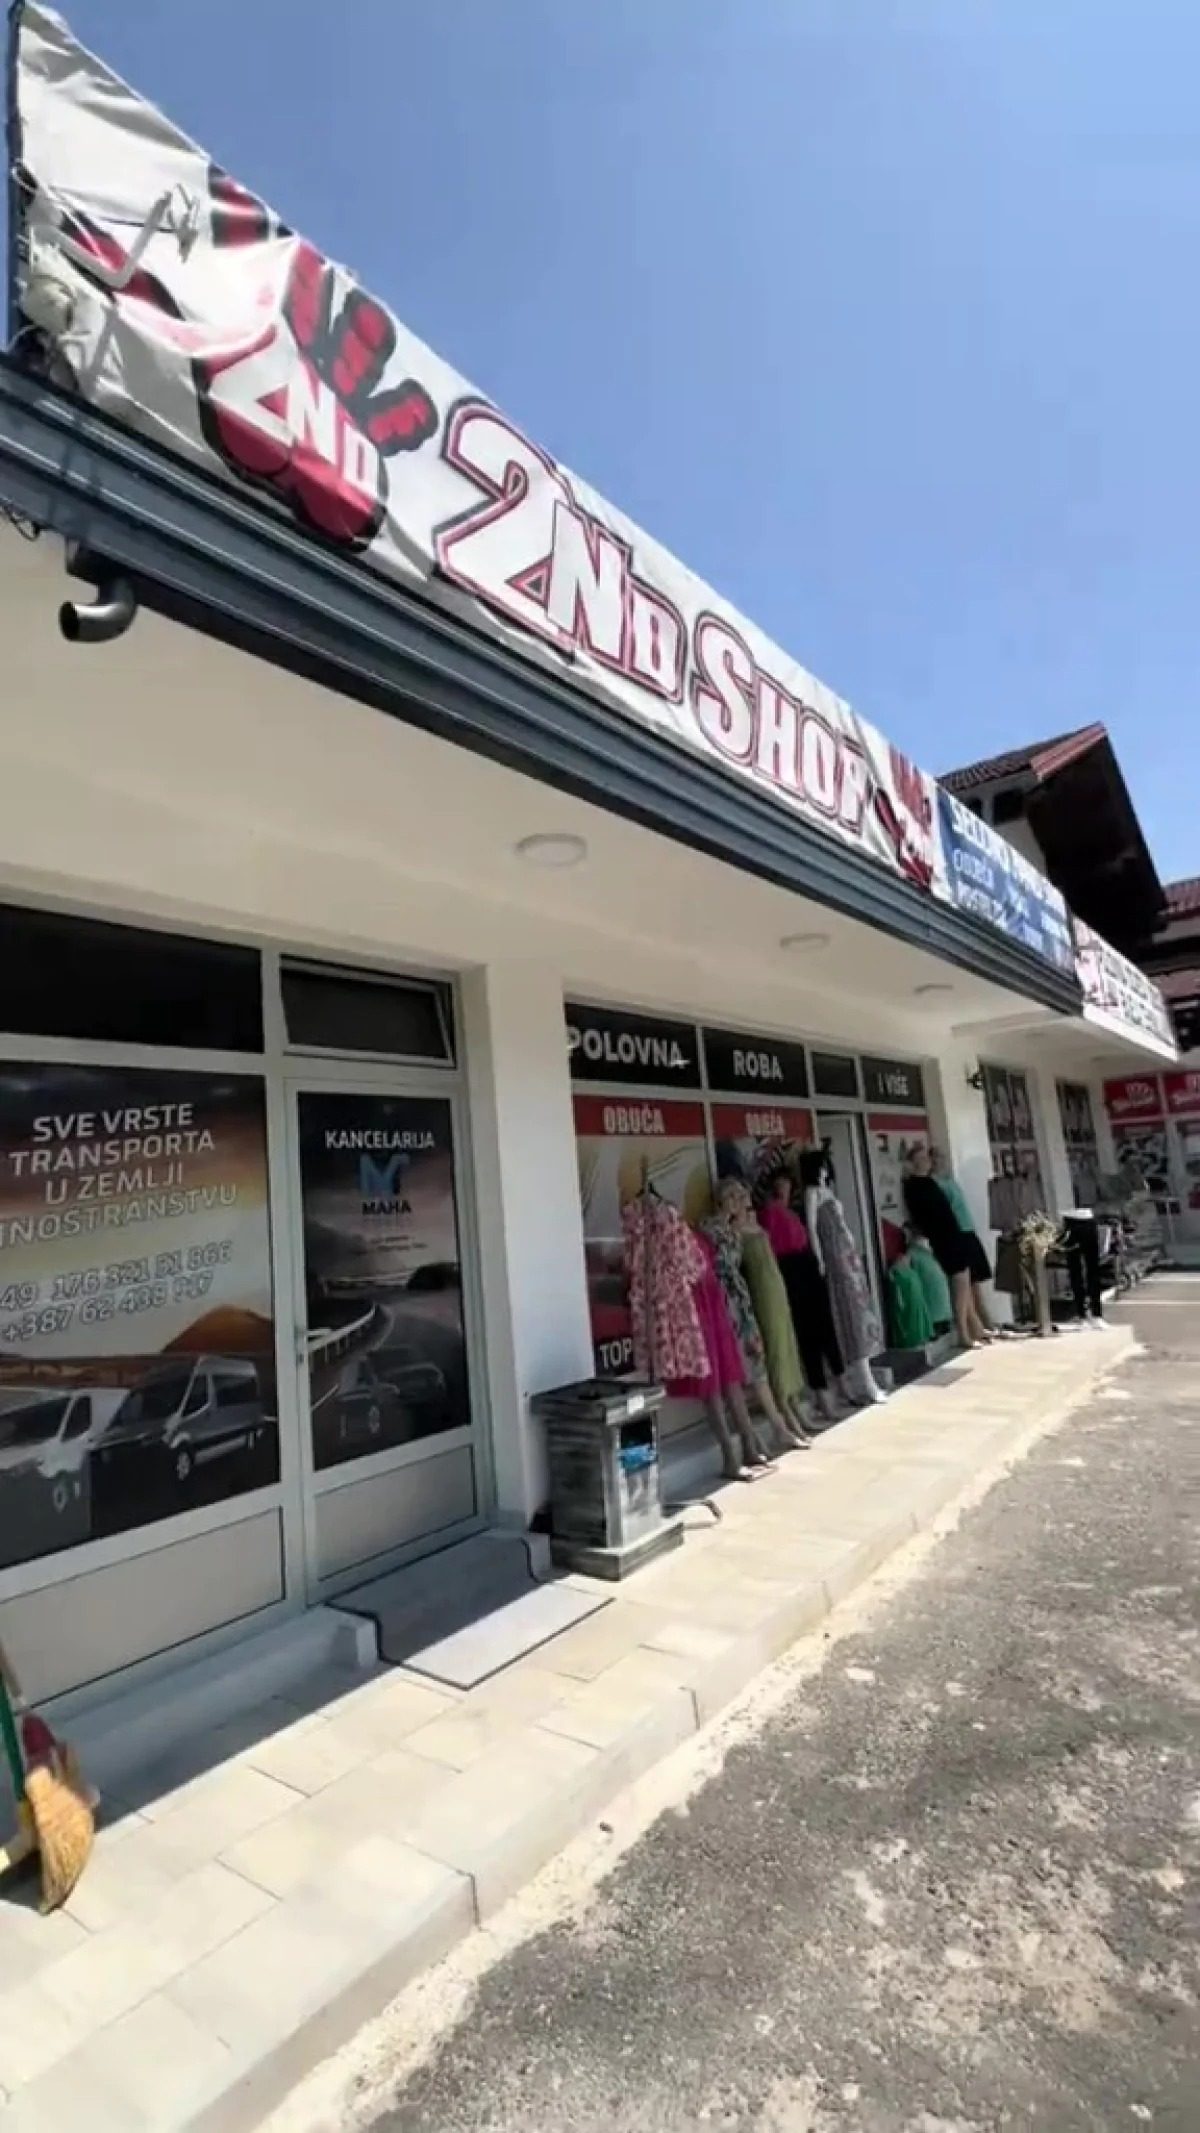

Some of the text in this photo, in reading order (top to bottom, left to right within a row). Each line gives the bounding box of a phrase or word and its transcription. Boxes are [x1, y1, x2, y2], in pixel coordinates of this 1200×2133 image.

[433, 396, 687, 703] 2ND
[566, 1026, 689, 1067] POLOVNA
[733, 1050, 784, 1081] ROBA
[33, 1103, 194, 1143] SVE VRSTE
[324, 1129, 436, 1149] KANCELARIJA
[9, 1129, 215, 1177] TRANSPORTA
[45, 1161, 183, 1205] U ZEMLJI
[362, 1200, 412, 1216] MAHA
[3, 1301, 76, 1342] +387
[598, 1337, 633, 1370] TOP
